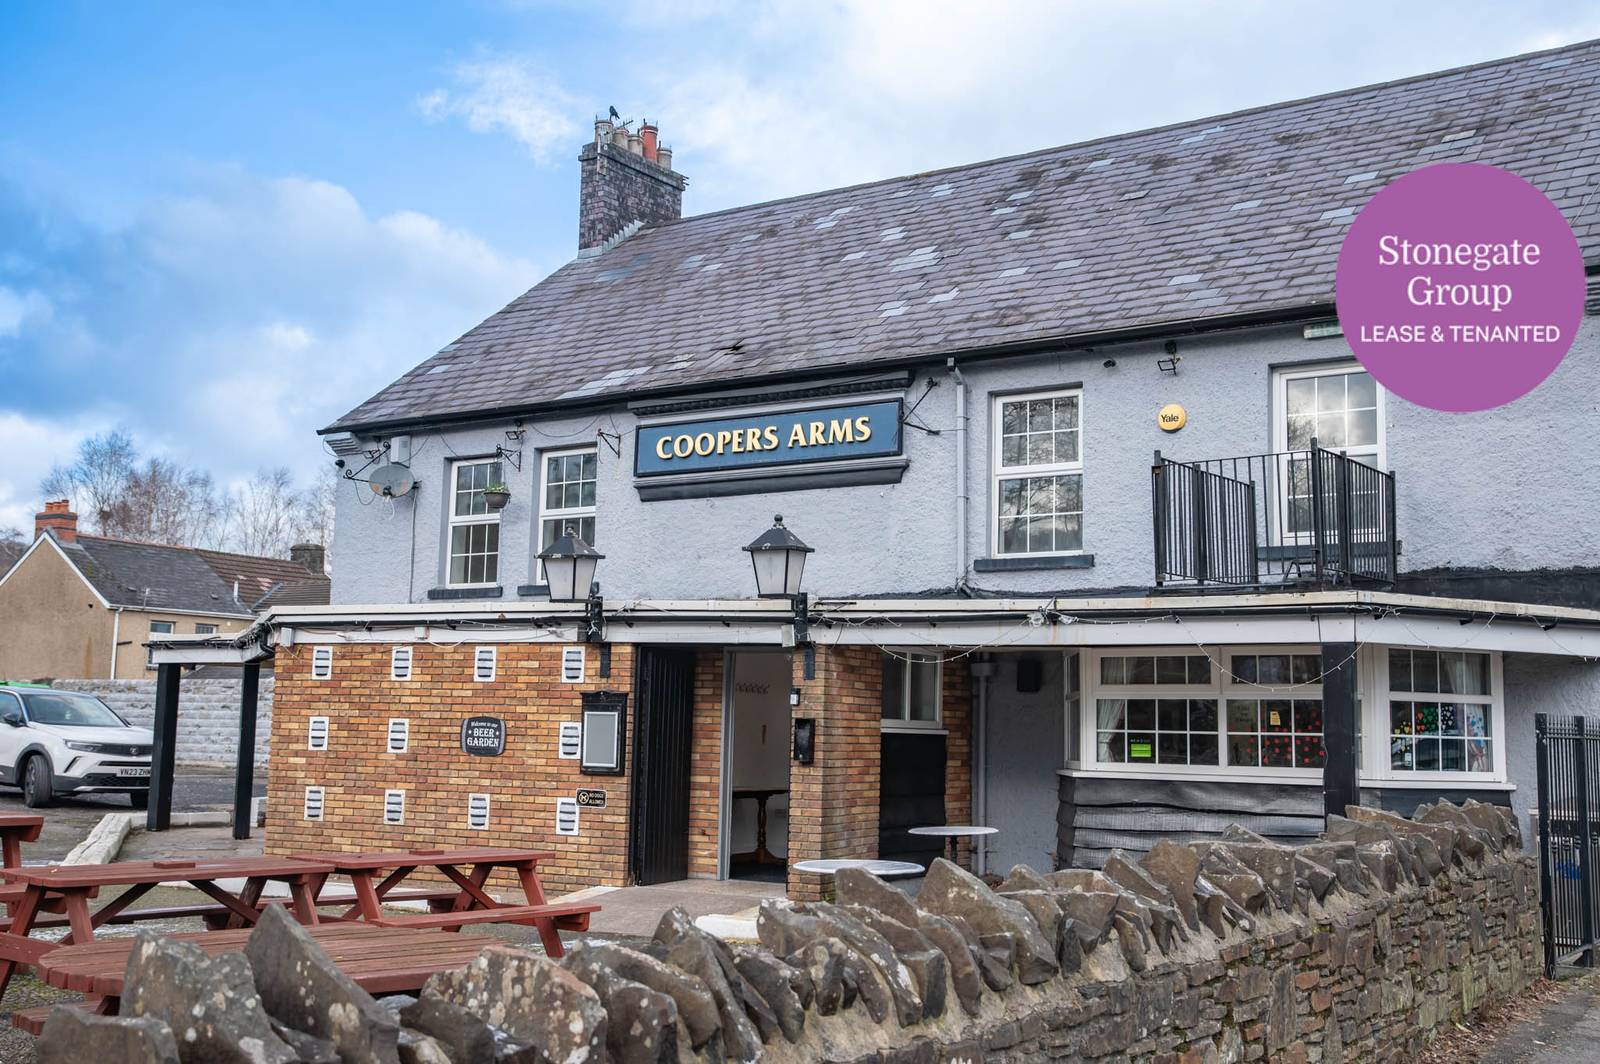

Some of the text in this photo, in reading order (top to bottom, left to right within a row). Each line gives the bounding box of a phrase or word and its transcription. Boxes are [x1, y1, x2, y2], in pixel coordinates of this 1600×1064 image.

[1161, 413, 1179, 423] Yale
[656, 416, 872, 459] COOPERS ARMS
[473, 728, 495, 737] BEER
[466, 737, 499, 747] GARDEN
